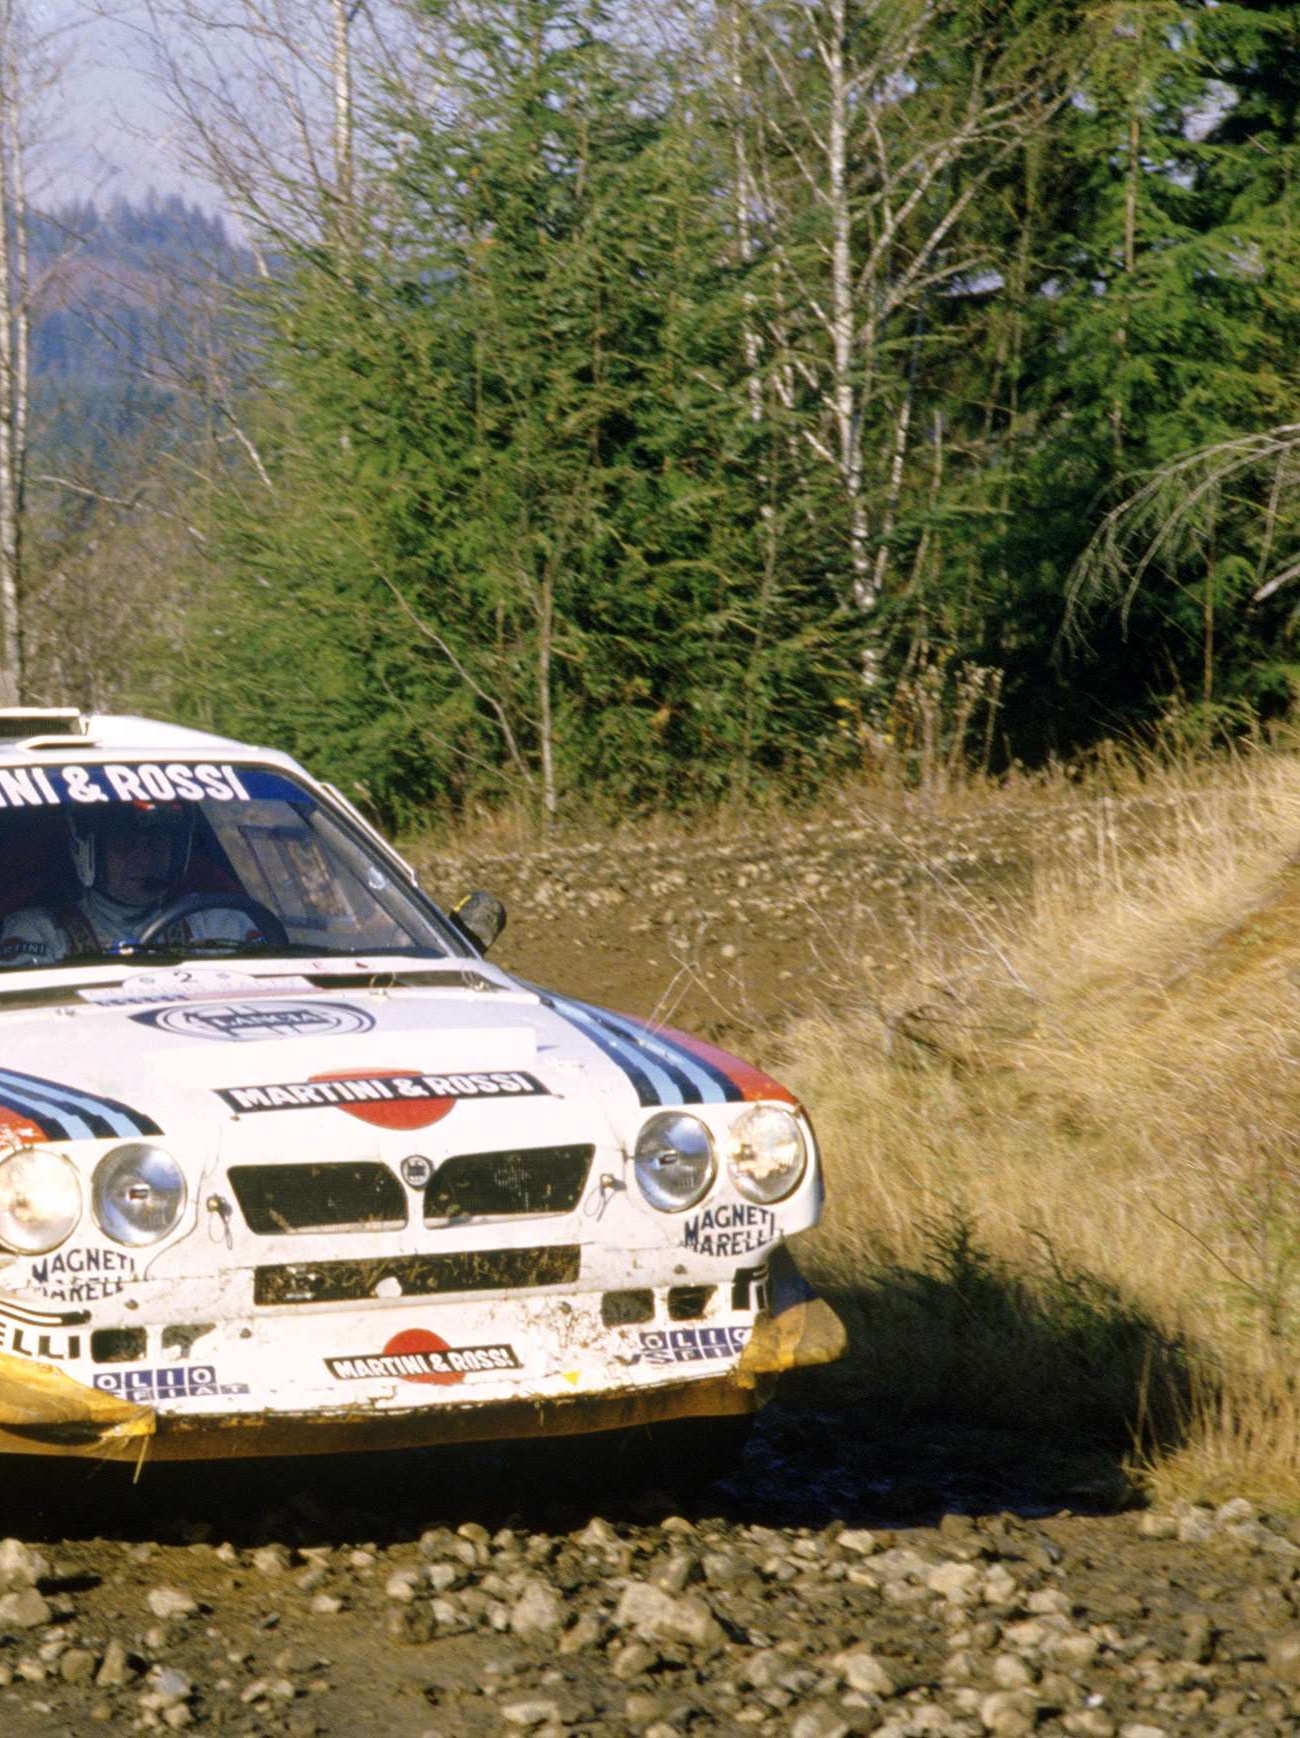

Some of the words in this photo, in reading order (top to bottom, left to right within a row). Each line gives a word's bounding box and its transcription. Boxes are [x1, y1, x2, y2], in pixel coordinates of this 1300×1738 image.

[60, 765, 109, 803] &
[104, 763, 251, 801] ROSSI
[229, 1079, 394, 1109] MARTINI
[397, 1077, 430, 1098] &
[422, 1072, 536, 1096] ROSSI
[31, 1248, 135, 1284] MAGNETI
[96, 1367, 213, 1390] OLIO
[332, 1355, 431, 1379] MARTINI
[428, 1352, 452, 1373] &
[447, 1347, 515, 1372] ROSSI
